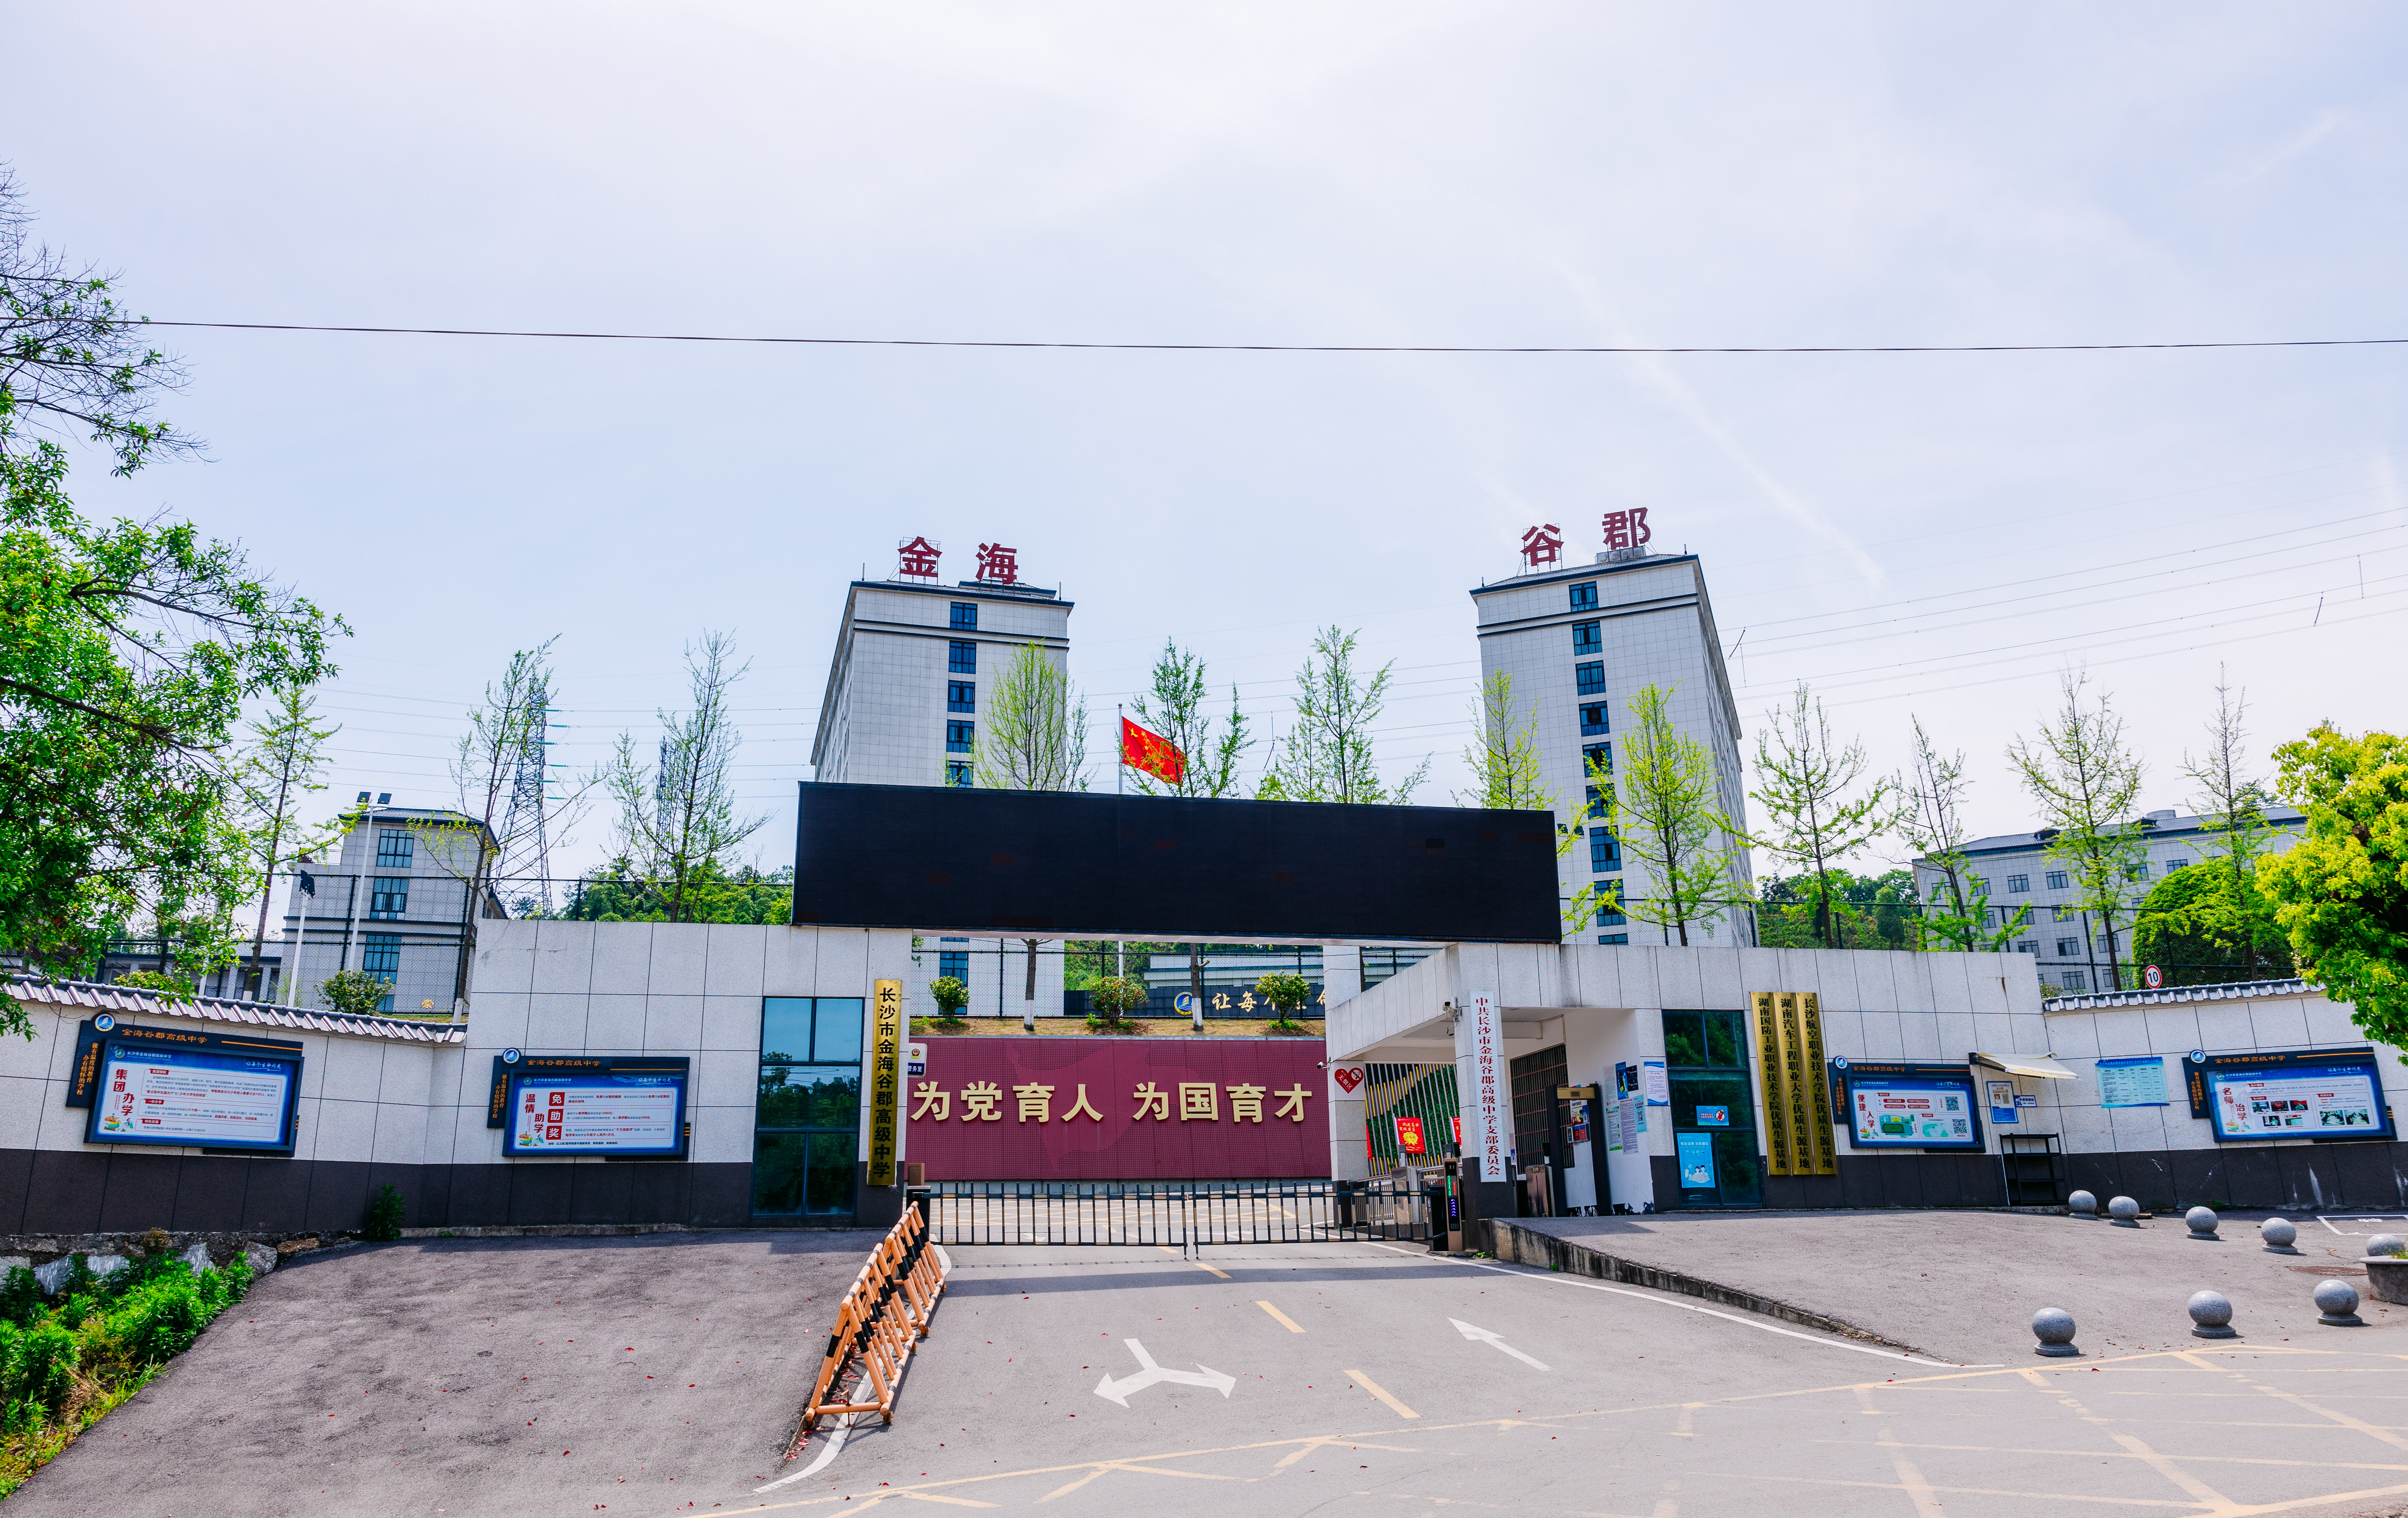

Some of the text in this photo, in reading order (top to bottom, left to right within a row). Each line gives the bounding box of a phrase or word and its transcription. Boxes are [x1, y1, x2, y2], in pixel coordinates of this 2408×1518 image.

[1520, 507, 1651, 567] 谷郡
[898, 536, 1018, 584] 金海
[2148, 972, 2158, 983] 10
[422, 999, 434, 1009] 崇
[122, 1029, 207, 1043] 金海谷郡高级中学
[86, 1043, 99, 1083] 做有温度的教育
[2215, 1055, 2286, 1063] 金海谷郡高级中学
[76, 1055, 89, 1095] 办有情怀的学校
[113, 1069, 128, 1092] 集团
[873, 987, 896, 1178] 长沙市金海谷郡高级中学
[1338, 1074, 1353, 1090] 无烟区
[1758, 998, 1787, 1168] 湖南国防工业职业技术学院优质生源基地
[1781, 998, 1810, 1168] 湖南汽车工程职业大学优质生源基地
[1803, 999, 1834, 1168] 长沙航空职业技术学院优质生源基地
[1476, 997, 1500, 1175] 中共长沙市金海谷郡高级中学支部委员会
[2223, 1087, 2233, 1104] 名师
[121, 1093, 135, 1115] 办学
[525, 1094, 535, 1113] 温情
[552, 1094, 562, 1104] 免
[910, 1081, 1312, 1123] 为党育人 为国育才
[1858, 1094, 1867, 1111] 便捷
[550, 1111, 560, 1121] 助
[1867, 1111, 1875, 1127] 入学
[2236, 1104, 2247, 1120] 治学
[534, 1113, 544, 1133] 助学
[549, 1128, 559, 1138] 奖
